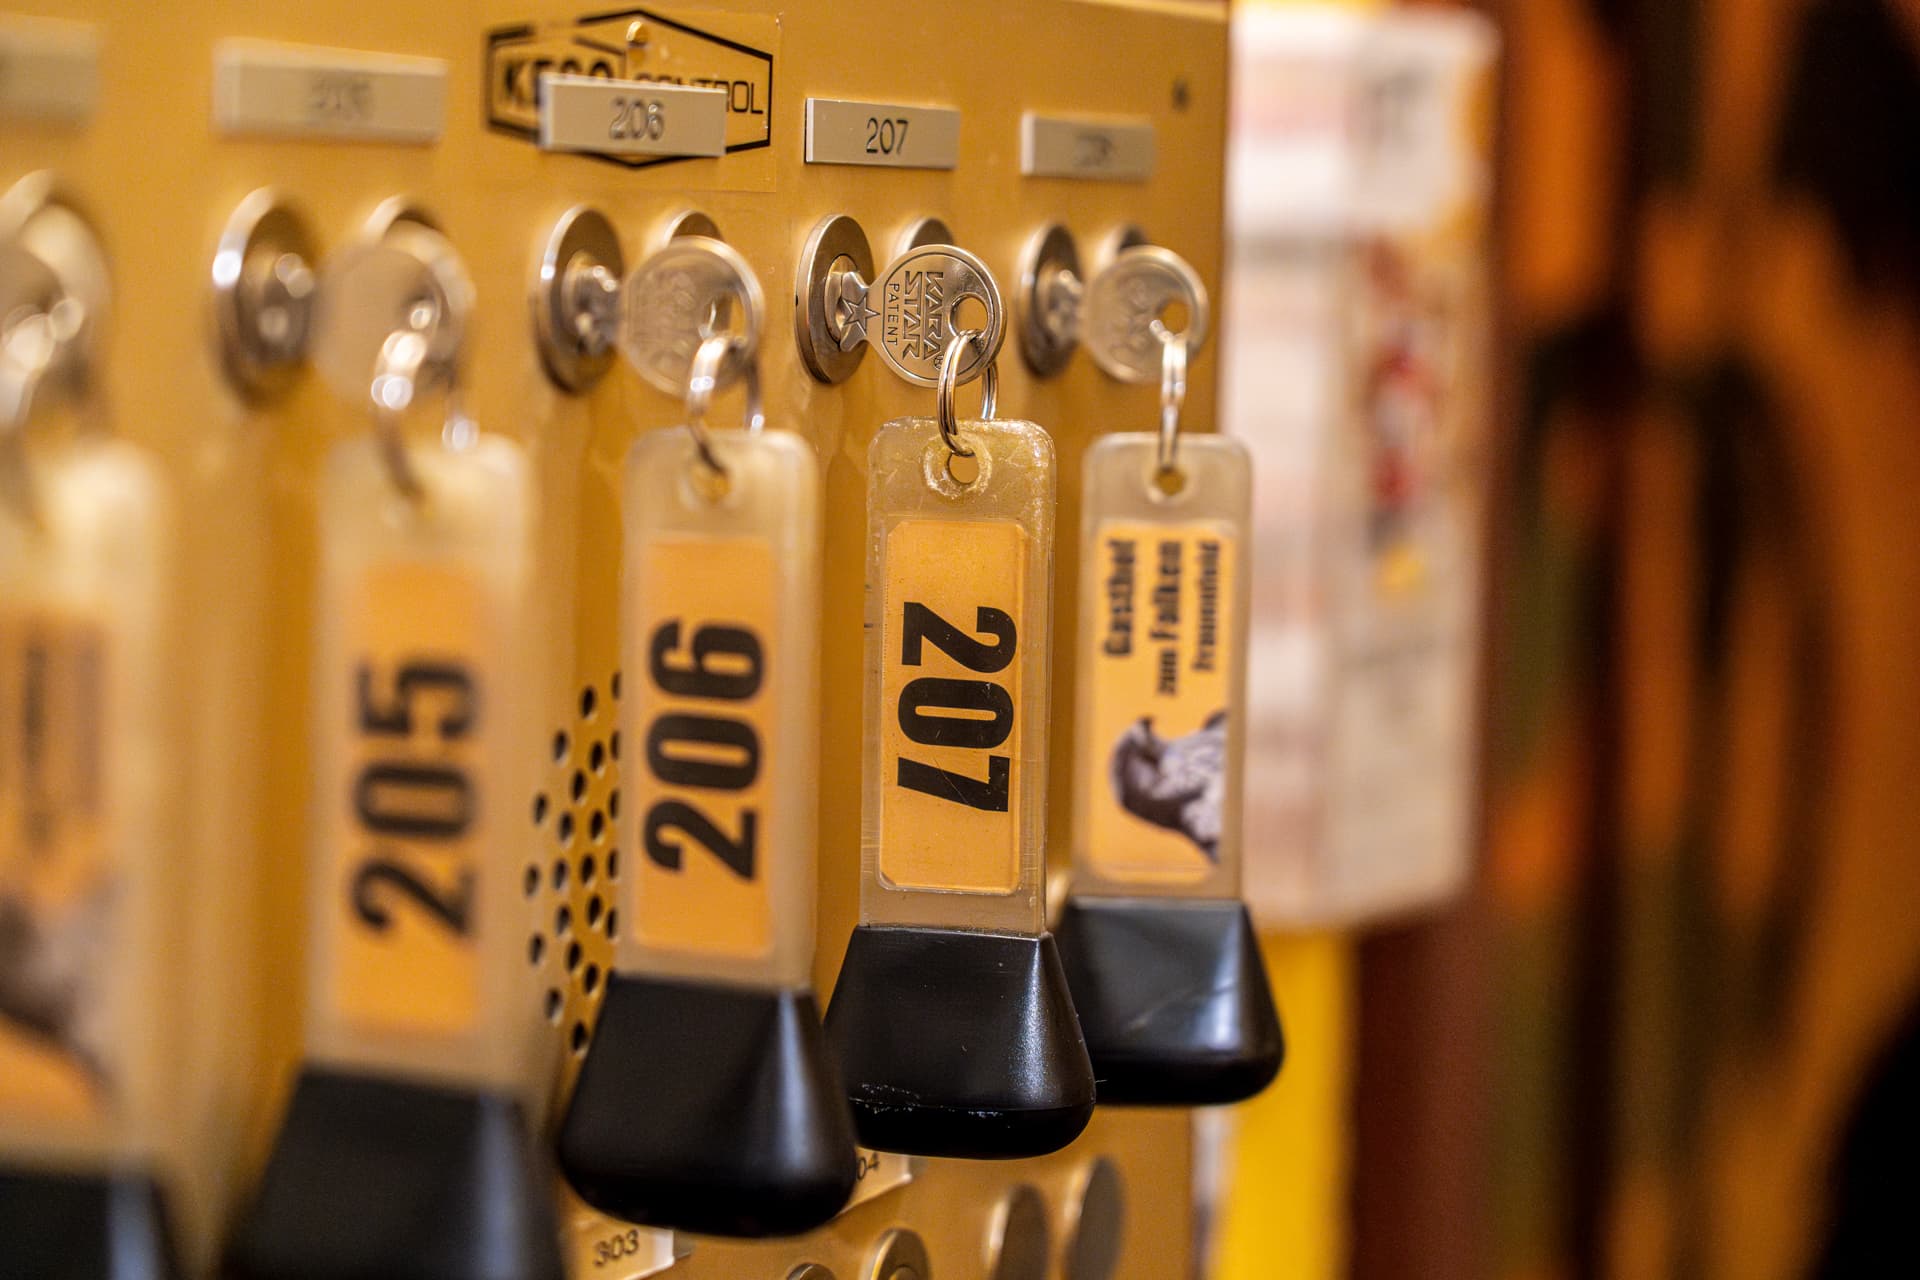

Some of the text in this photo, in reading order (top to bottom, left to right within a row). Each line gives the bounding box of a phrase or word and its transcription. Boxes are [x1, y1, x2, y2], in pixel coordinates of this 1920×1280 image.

[608, 97, 664, 140] 206
[866, 117, 909, 155] 207
[887, 283, 900, 346] PATENT
[902, 270, 922, 360] STAR
[1149, 540, 1182, 641] Falken
[897, 601, 1018, 812] 207
[644, 616, 766, 880] 206
[351, 656, 478, 938] 205
[855, 1151, 880, 1182] 04
[594, 1228, 639, 1268] 303
